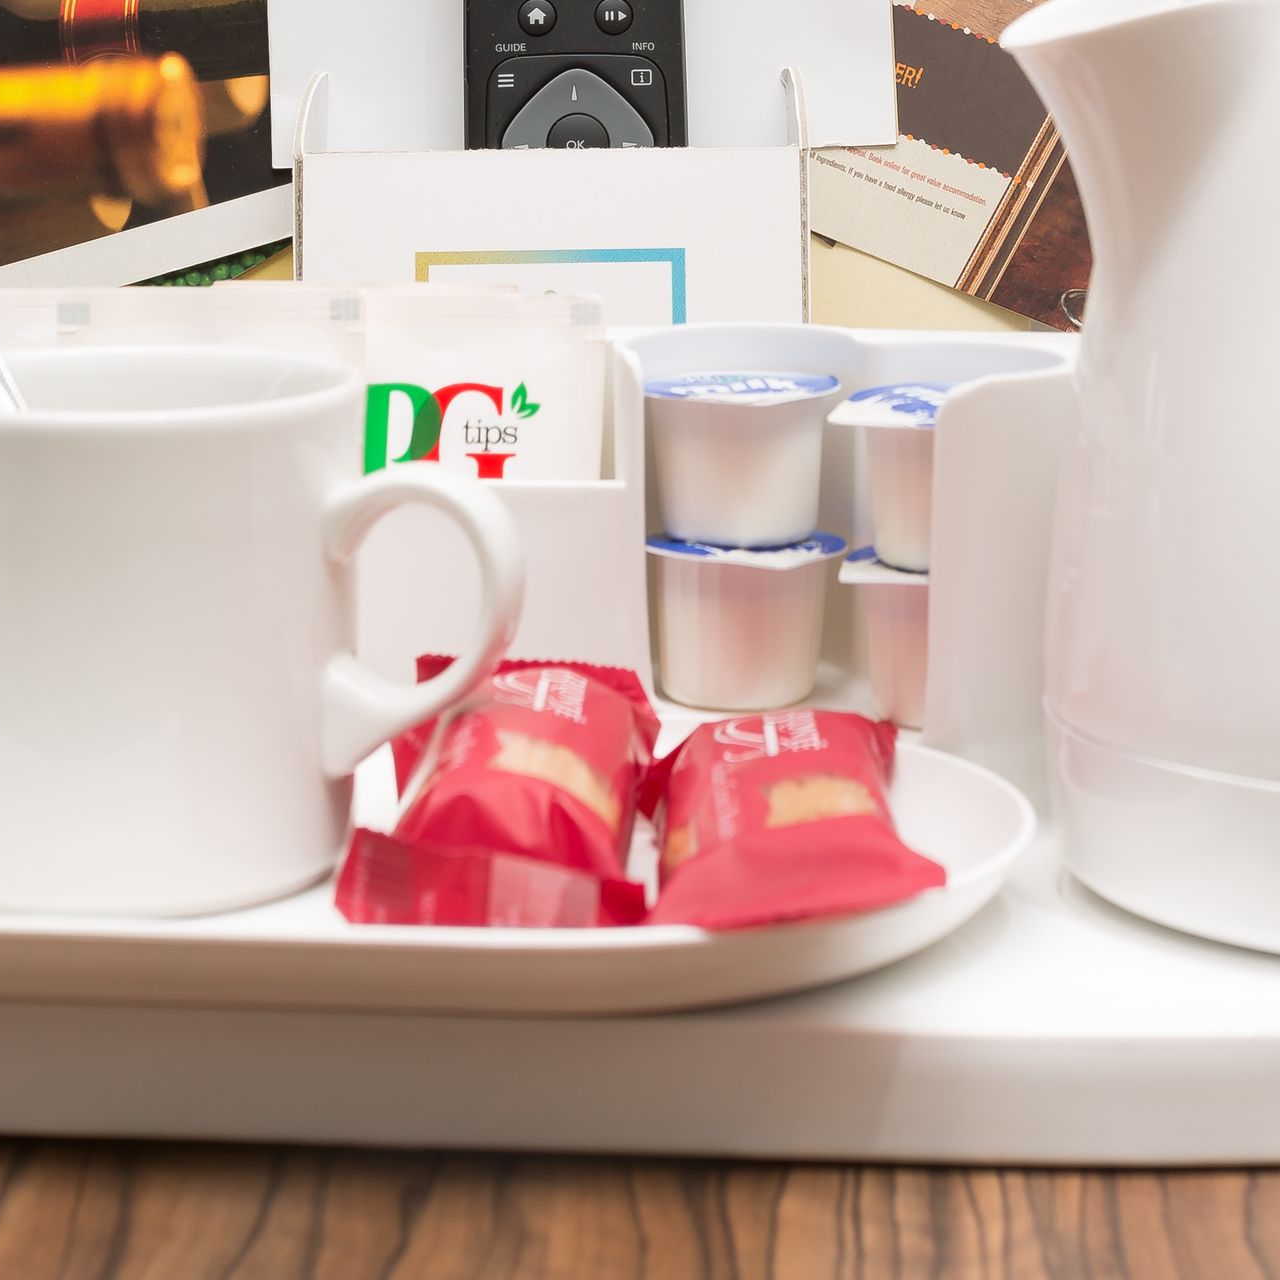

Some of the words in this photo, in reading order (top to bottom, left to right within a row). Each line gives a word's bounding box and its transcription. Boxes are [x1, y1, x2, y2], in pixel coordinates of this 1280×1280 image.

[495, 42, 528, 53] GUIDE
[632, 42, 656, 52] INFO
[566, 139, 586, 150] OK
[463, 419, 518, 453] tips
